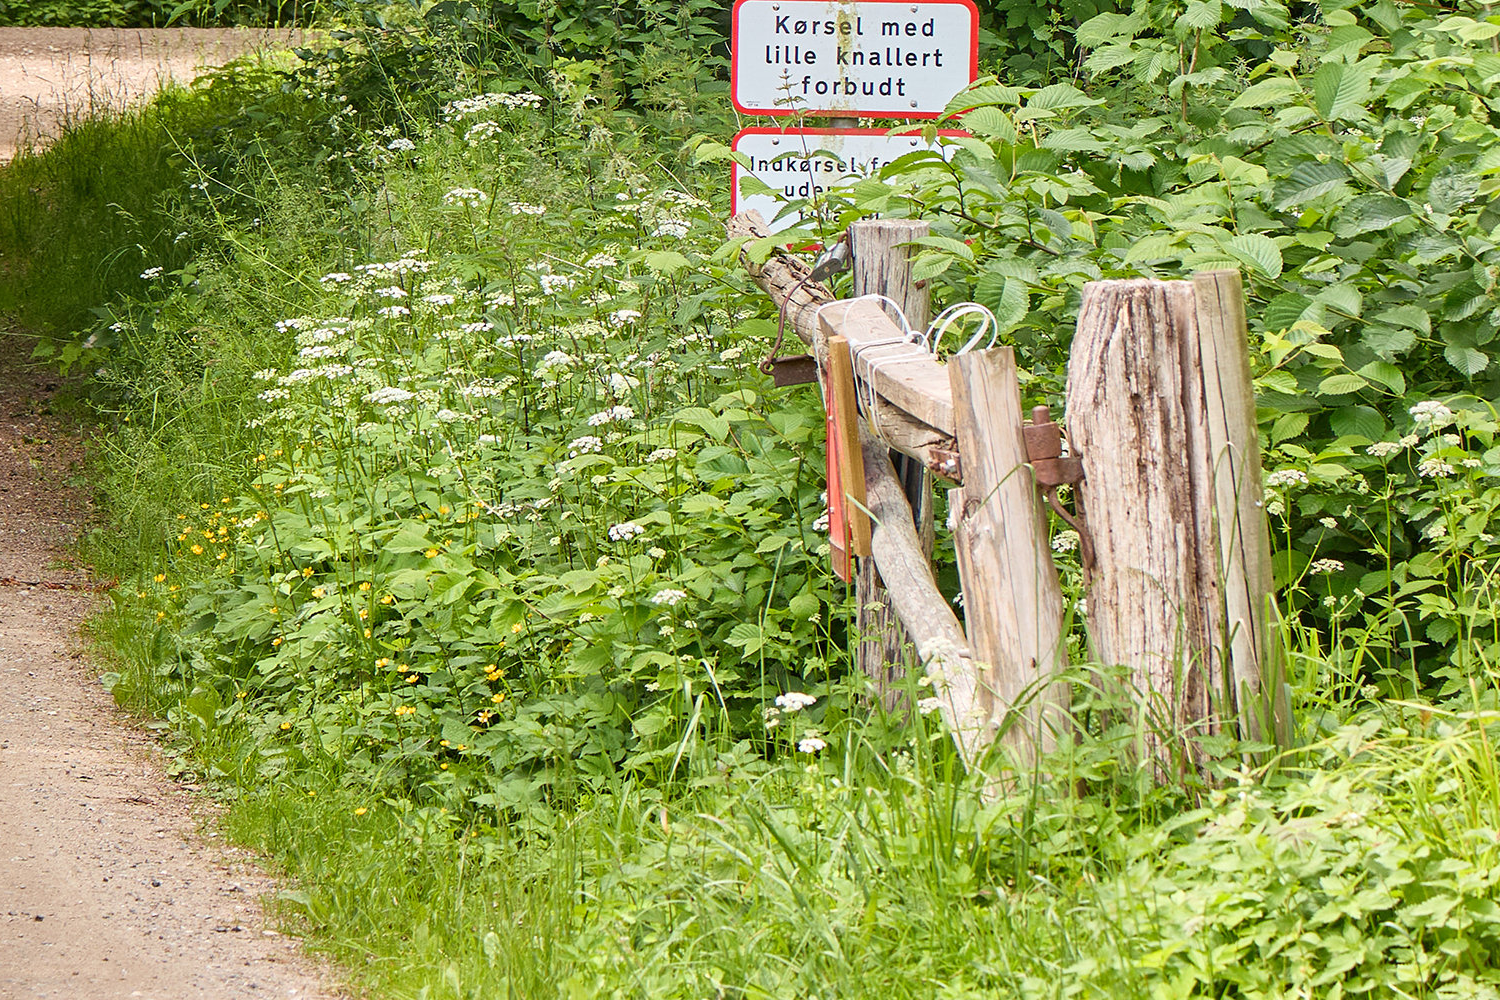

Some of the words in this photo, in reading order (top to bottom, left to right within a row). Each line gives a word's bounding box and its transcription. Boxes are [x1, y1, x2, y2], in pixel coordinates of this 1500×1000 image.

[775, 15, 864, 35] Kørsel
[881, 18, 934, 36] med
[765, 45, 817, 64] lille
[836, 46, 943, 67] knallert
[802, 76, 906, 96] forbudt
